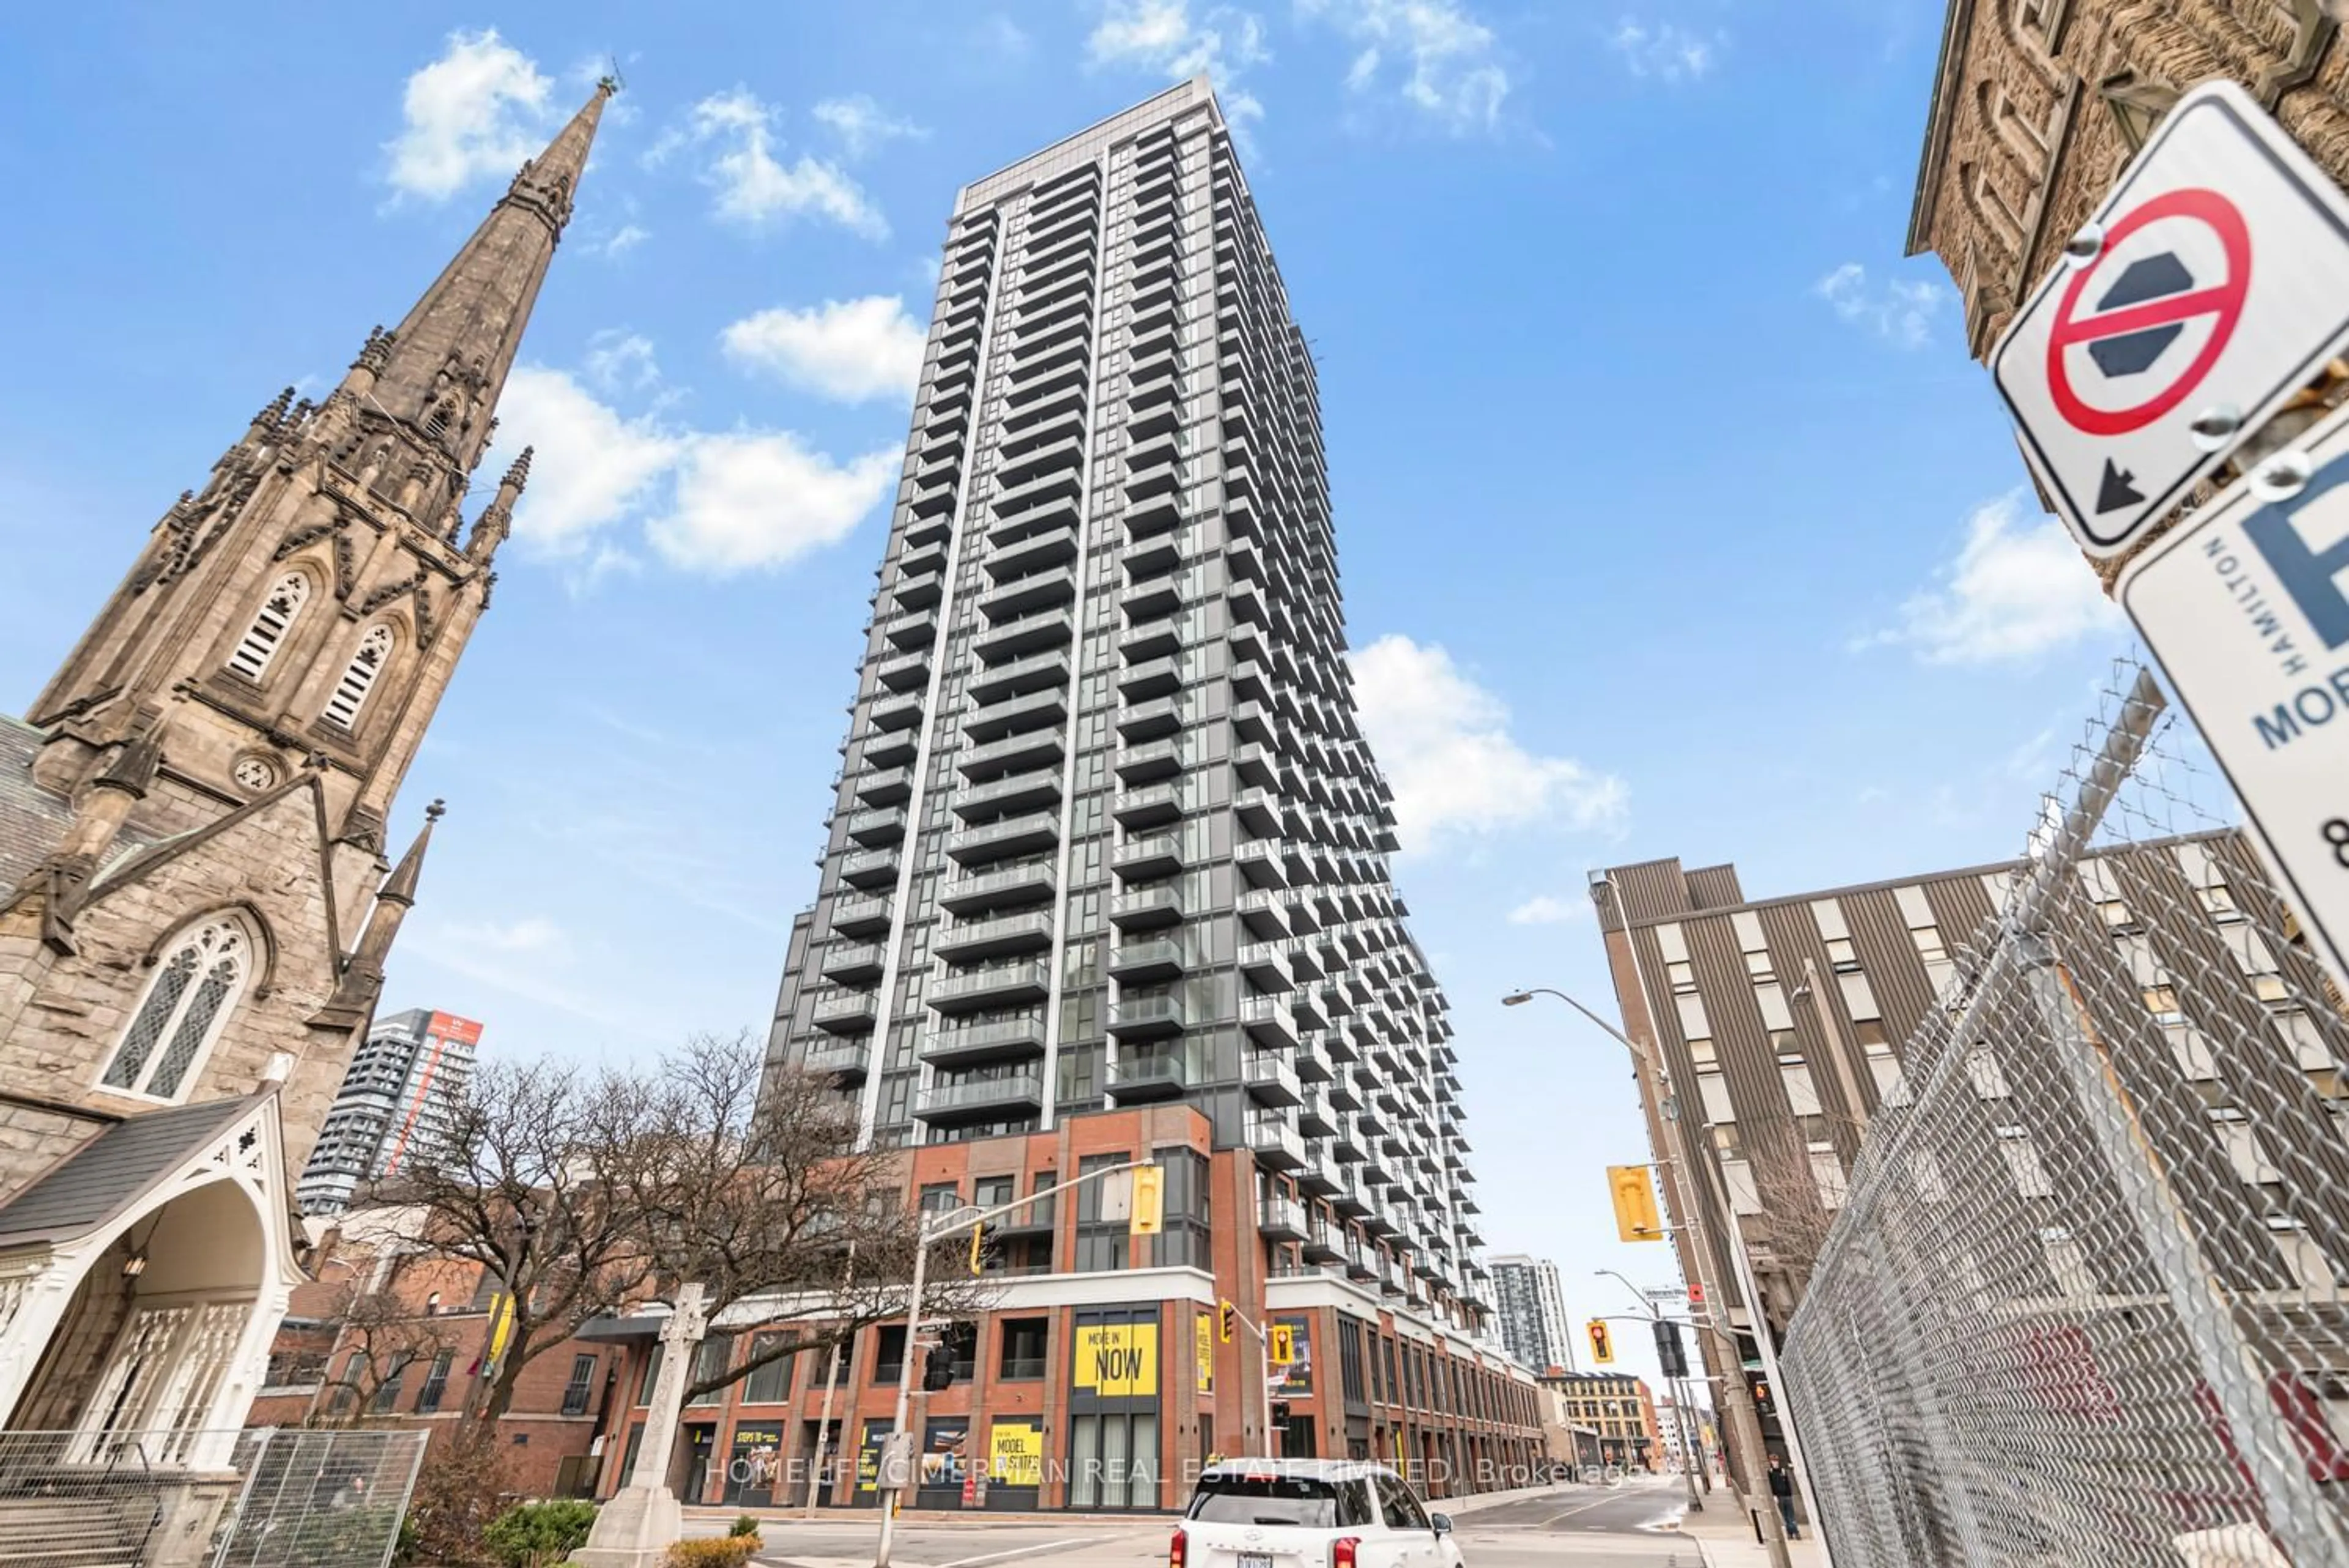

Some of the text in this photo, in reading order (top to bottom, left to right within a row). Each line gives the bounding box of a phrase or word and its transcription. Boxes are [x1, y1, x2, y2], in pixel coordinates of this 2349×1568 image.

[2202, 536, 2309, 677] HAMILTON
[1088, 1331, 1120, 1347] MOVE IN
[1096, 1347, 1142, 1381] NOW
[997, 1438, 1026, 1454] MODEL
[1008, 1455, 1039, 1470] SUITES
